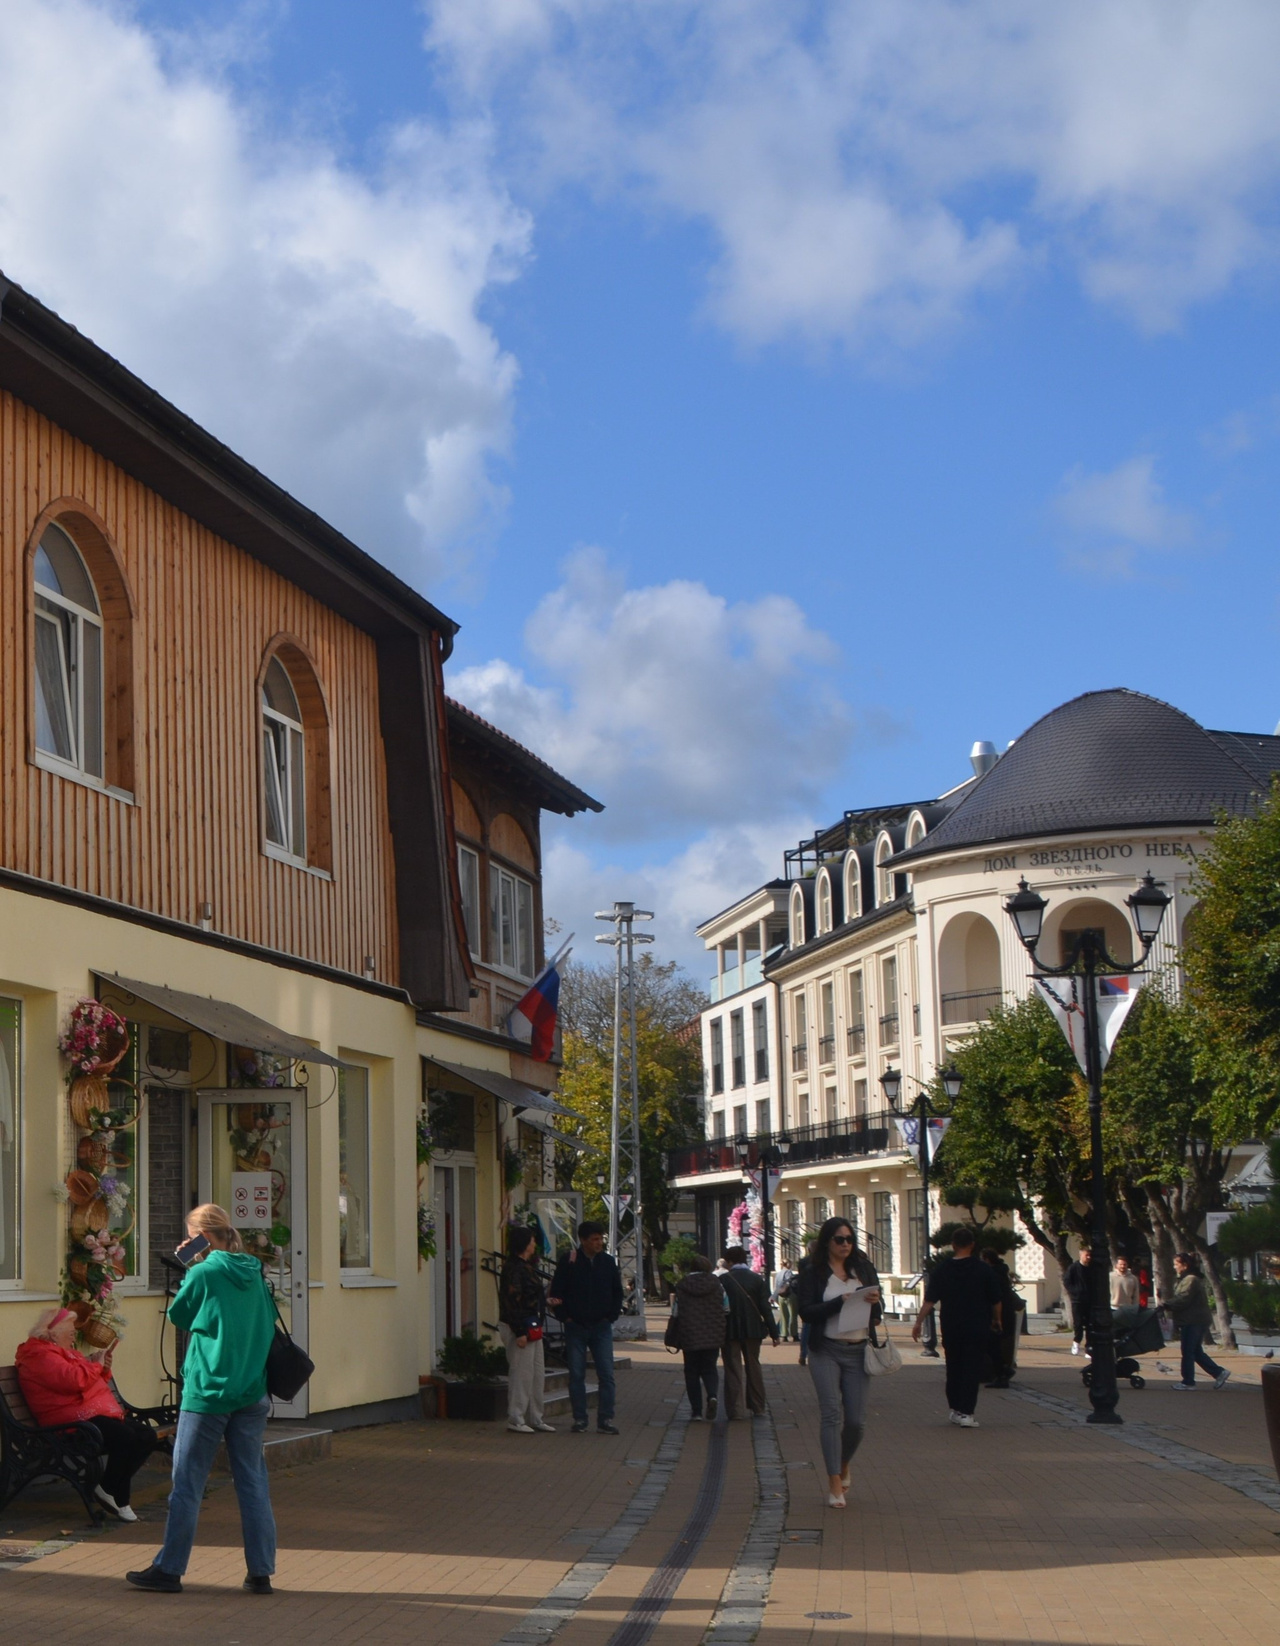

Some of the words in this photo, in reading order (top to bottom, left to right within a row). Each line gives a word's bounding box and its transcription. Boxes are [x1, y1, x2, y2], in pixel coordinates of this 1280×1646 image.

[983, 856, 1016, 874] ДОМ
[1029, 844, 1133, 867] ЗВЕЗДНОГО
[1054, 864, 1103, 877] ОТЕЛЬ
